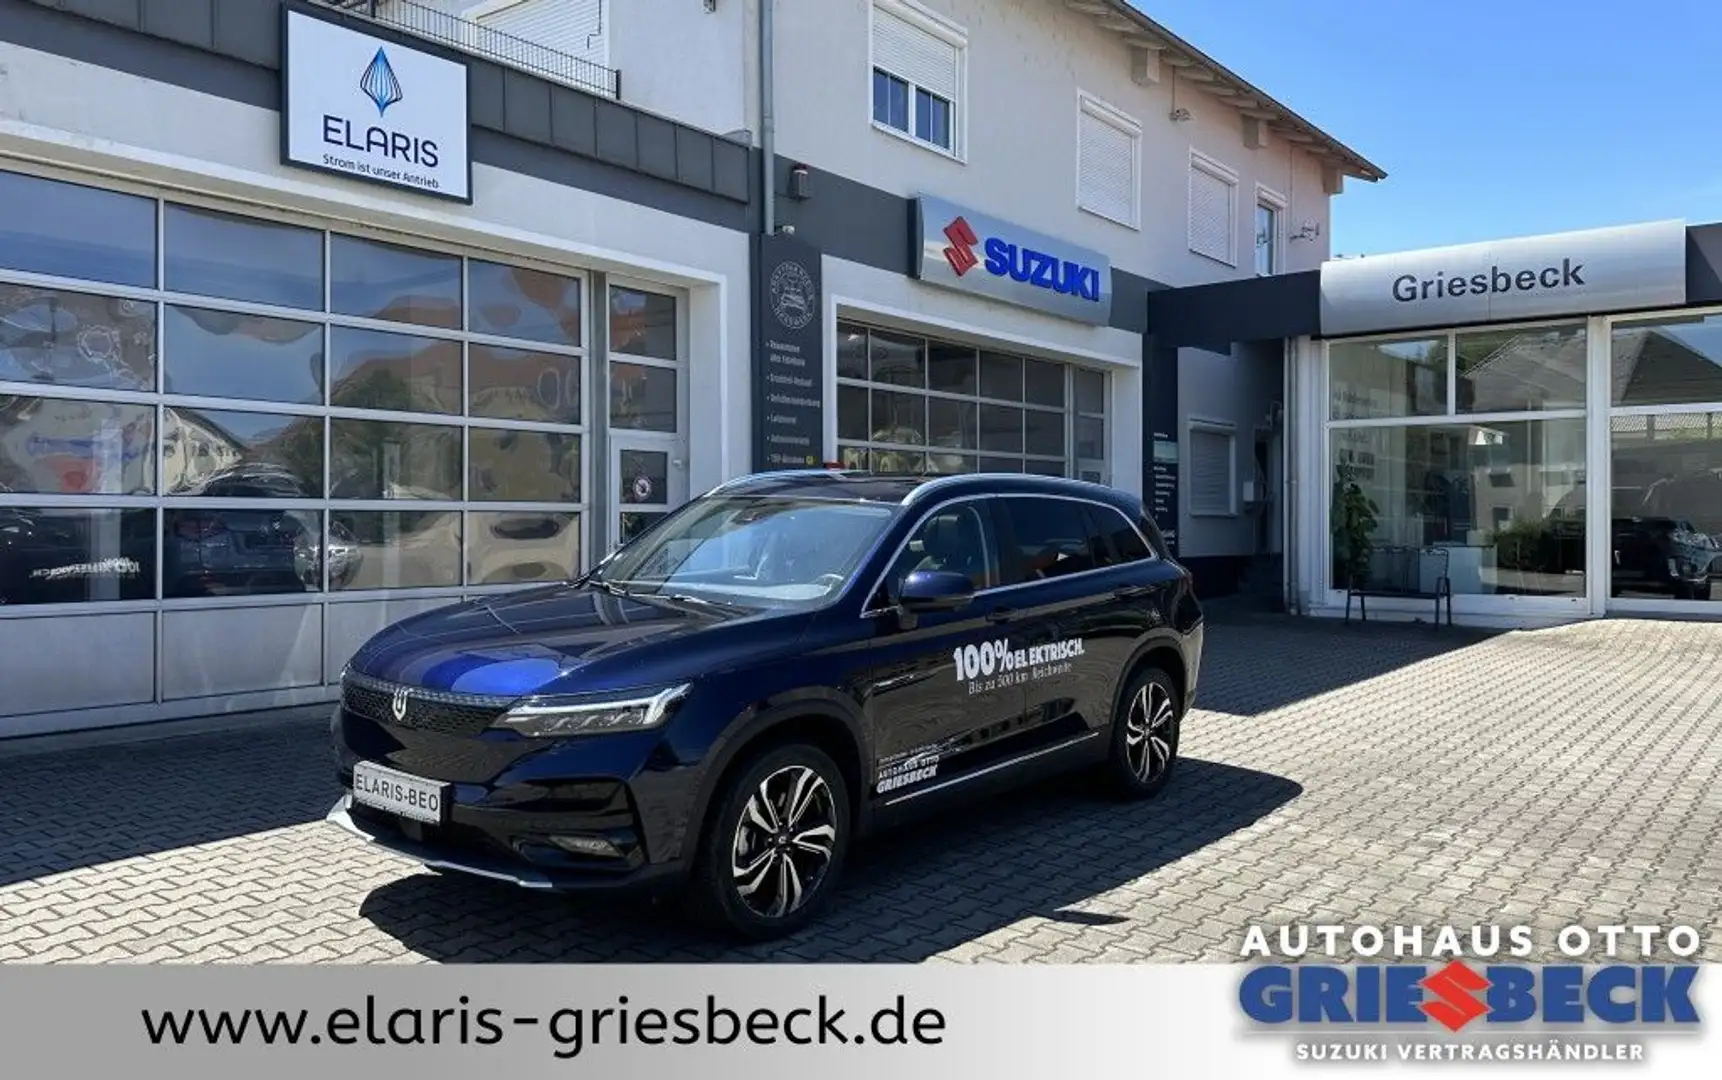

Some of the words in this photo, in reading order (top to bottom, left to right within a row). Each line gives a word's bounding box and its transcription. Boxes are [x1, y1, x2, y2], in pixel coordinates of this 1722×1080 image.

[323, 114, 438, 168] ELARIS
[323, 153, 355, 170] Strom
[357, 160, 371, 174] ist
[372, 166, 401, 181] unser
[403, 172, 439, 189] Antrieb
[984, 237, 1100, 302] SUZUKI
[1392, 258, 1585, 302] Griesbeck
[968, 680, 983, 695] Bis
[985, 680, 996, 691] zu
[355, 773, 439, 812] ELARIS-BEO
[876, 764, 939, 794] GRIESBECK
